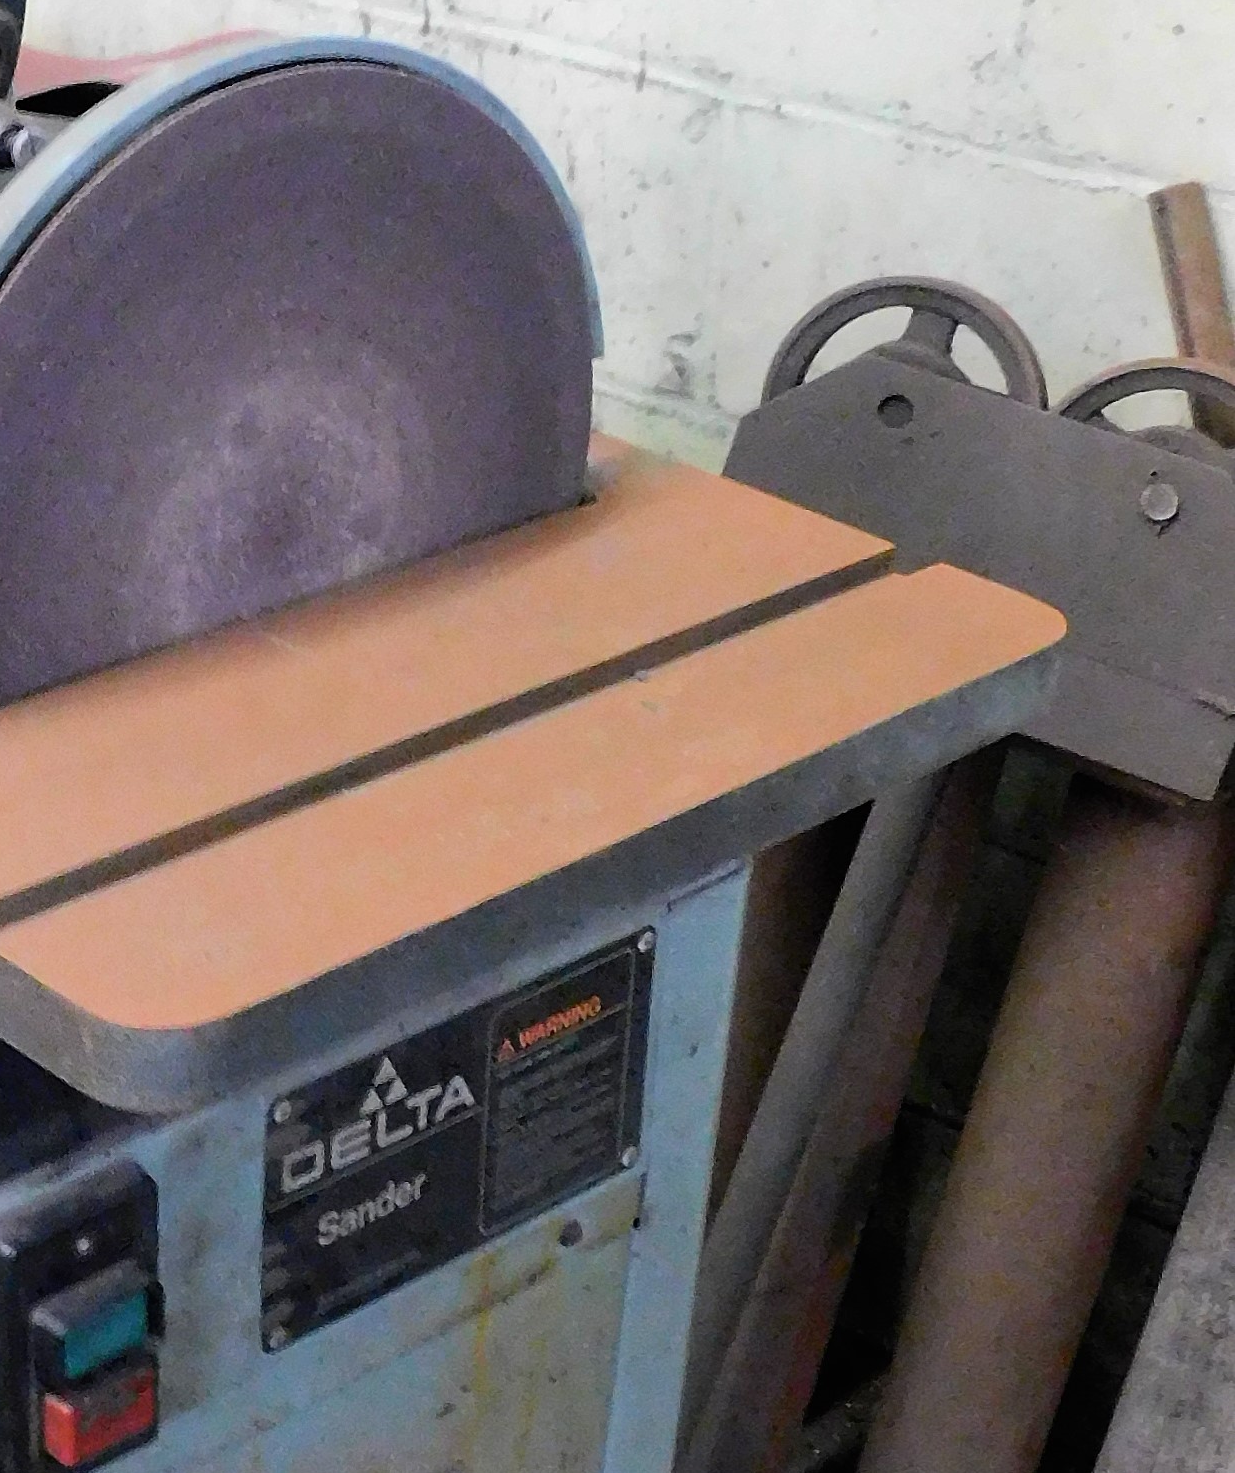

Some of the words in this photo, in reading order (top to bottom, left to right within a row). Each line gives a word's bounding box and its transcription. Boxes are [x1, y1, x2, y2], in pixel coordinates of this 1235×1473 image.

[519, 995, 602, 1049] WARNING
[280, 1075, 475, 1194] DELTA
[317, 1174, 427, 1247] Sander
